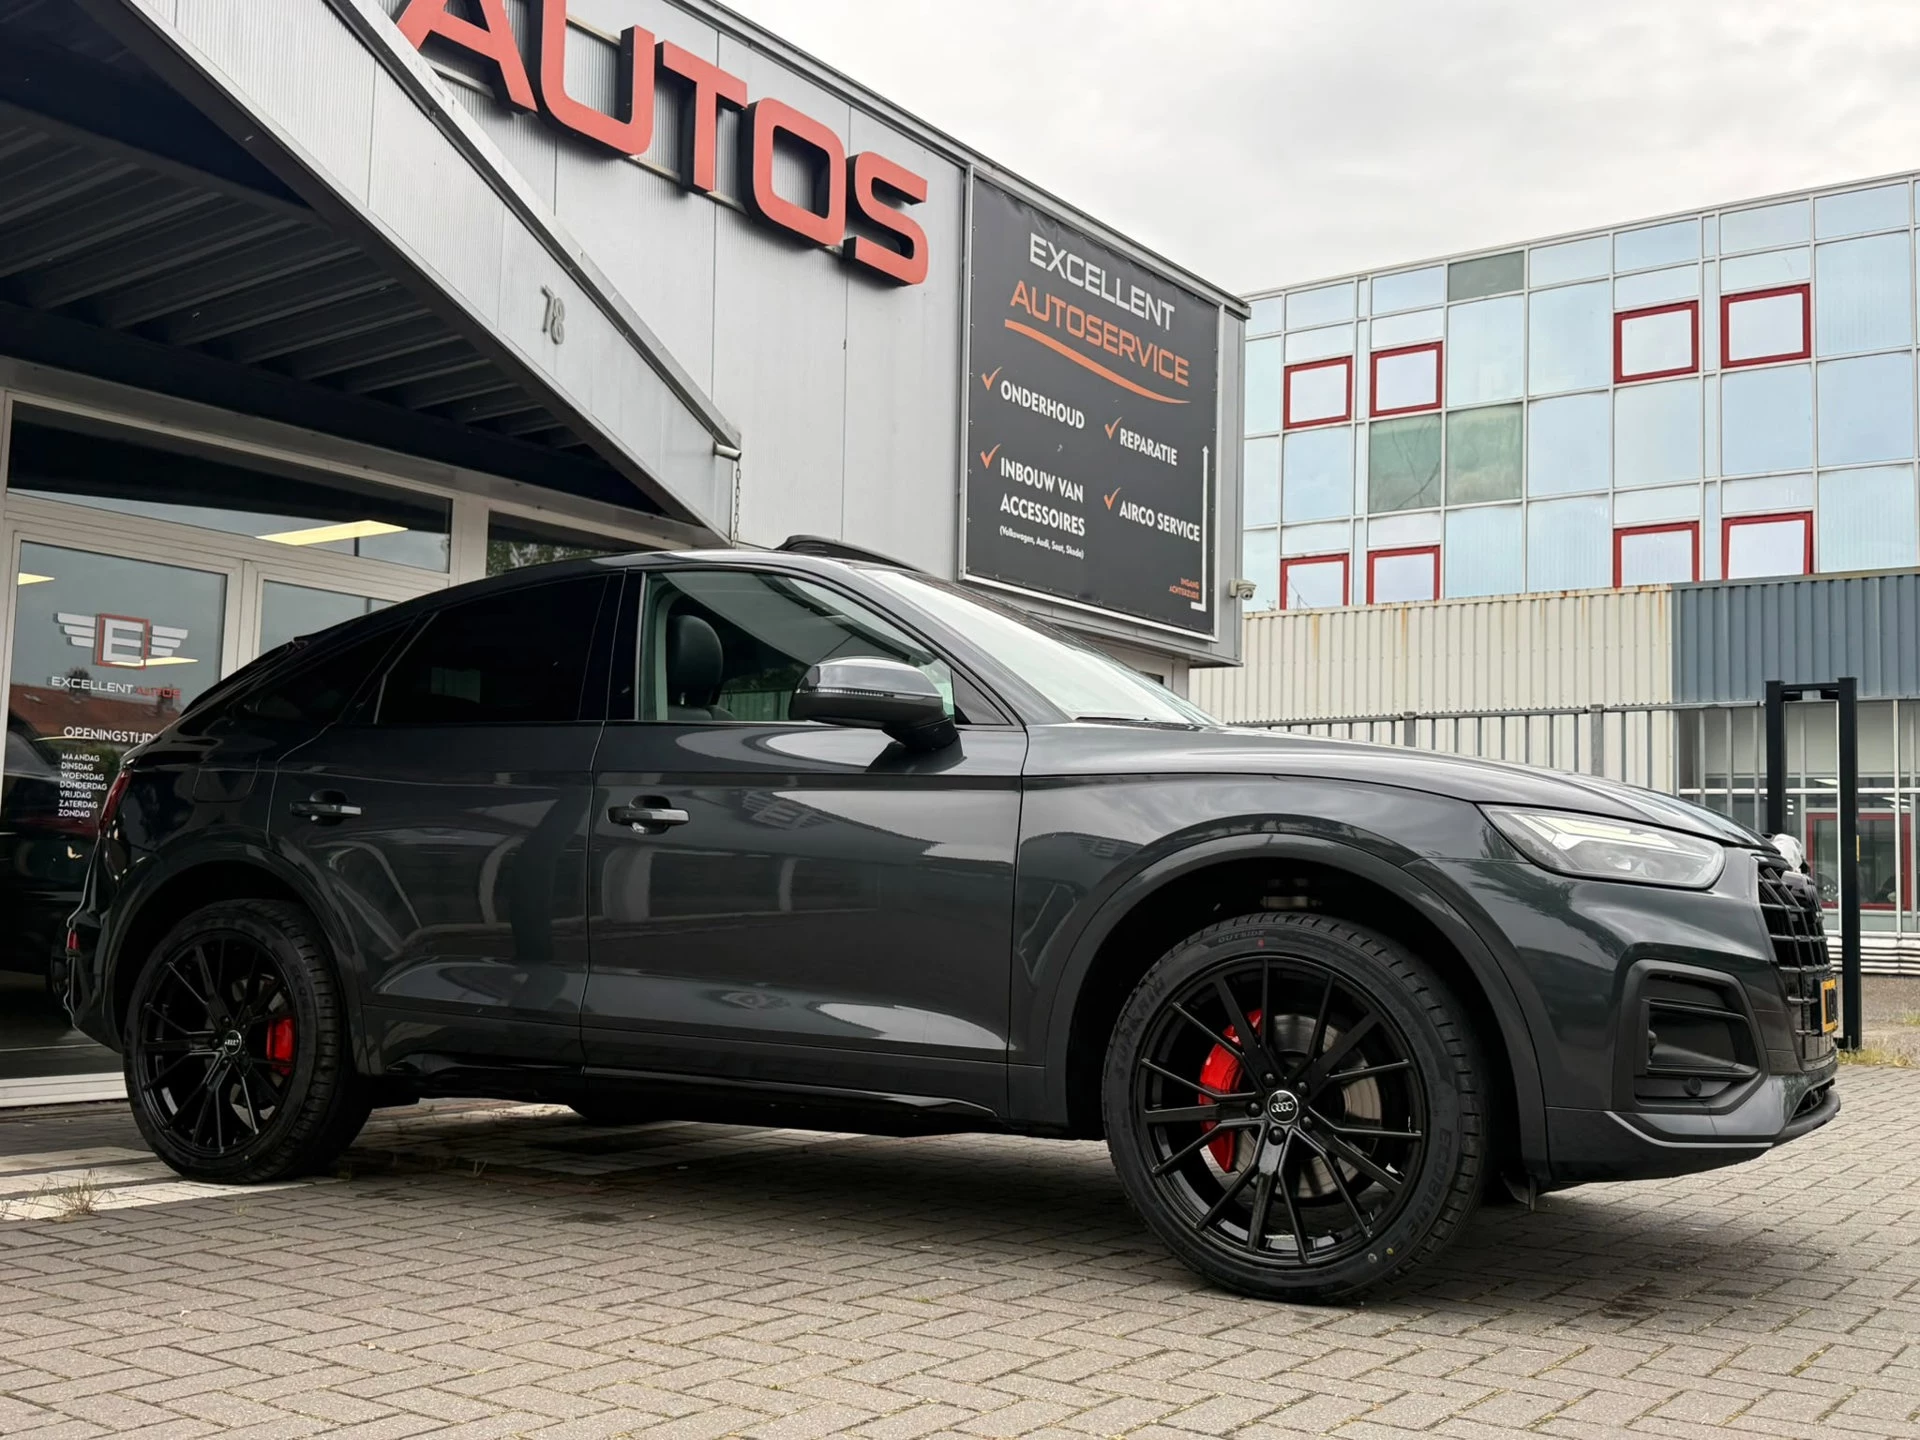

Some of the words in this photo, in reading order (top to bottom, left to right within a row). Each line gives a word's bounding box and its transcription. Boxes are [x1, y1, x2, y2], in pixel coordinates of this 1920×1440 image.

[397, 0, 928, 285] AUTOS
[1029, 232, 1175, 330] EXCELLENT
[541, 285, 565, 345] 78
[1010, 280, 1189, 387] AUTOSERVICE
[1000, 380, 1085, 429] ONDERHOUD
[1119, 427, 1178, 466] REPARATIE
[1000, 457, 1056, 493] INBOUW
[1058, 478, 1084, 503] VAN
[1000, 493, 1086, 536] ACCESSOIRES
[1119, 501, 1155, 527] AIRCO
[1157, 512, 1201, 542] SERVICE
[51, 676, 134, 694] EXCELLENT
[136, 687, 182, 698] AUTOS
[64, 726, 158, 743] OPENINGSTIJD
[61, 762, 94, 771] DINSDAG
[62, 753, 100, 762] MAANDAG
[60, 781, 108, 790] DONDERDAG
[61, 772, 105, 781] WOENSDAG
[59, 800, 98, 808] ZATERDAG
[60, 790, 92, 799] VRIJDAG
[58, 809, 90, 817] ZONDAG
